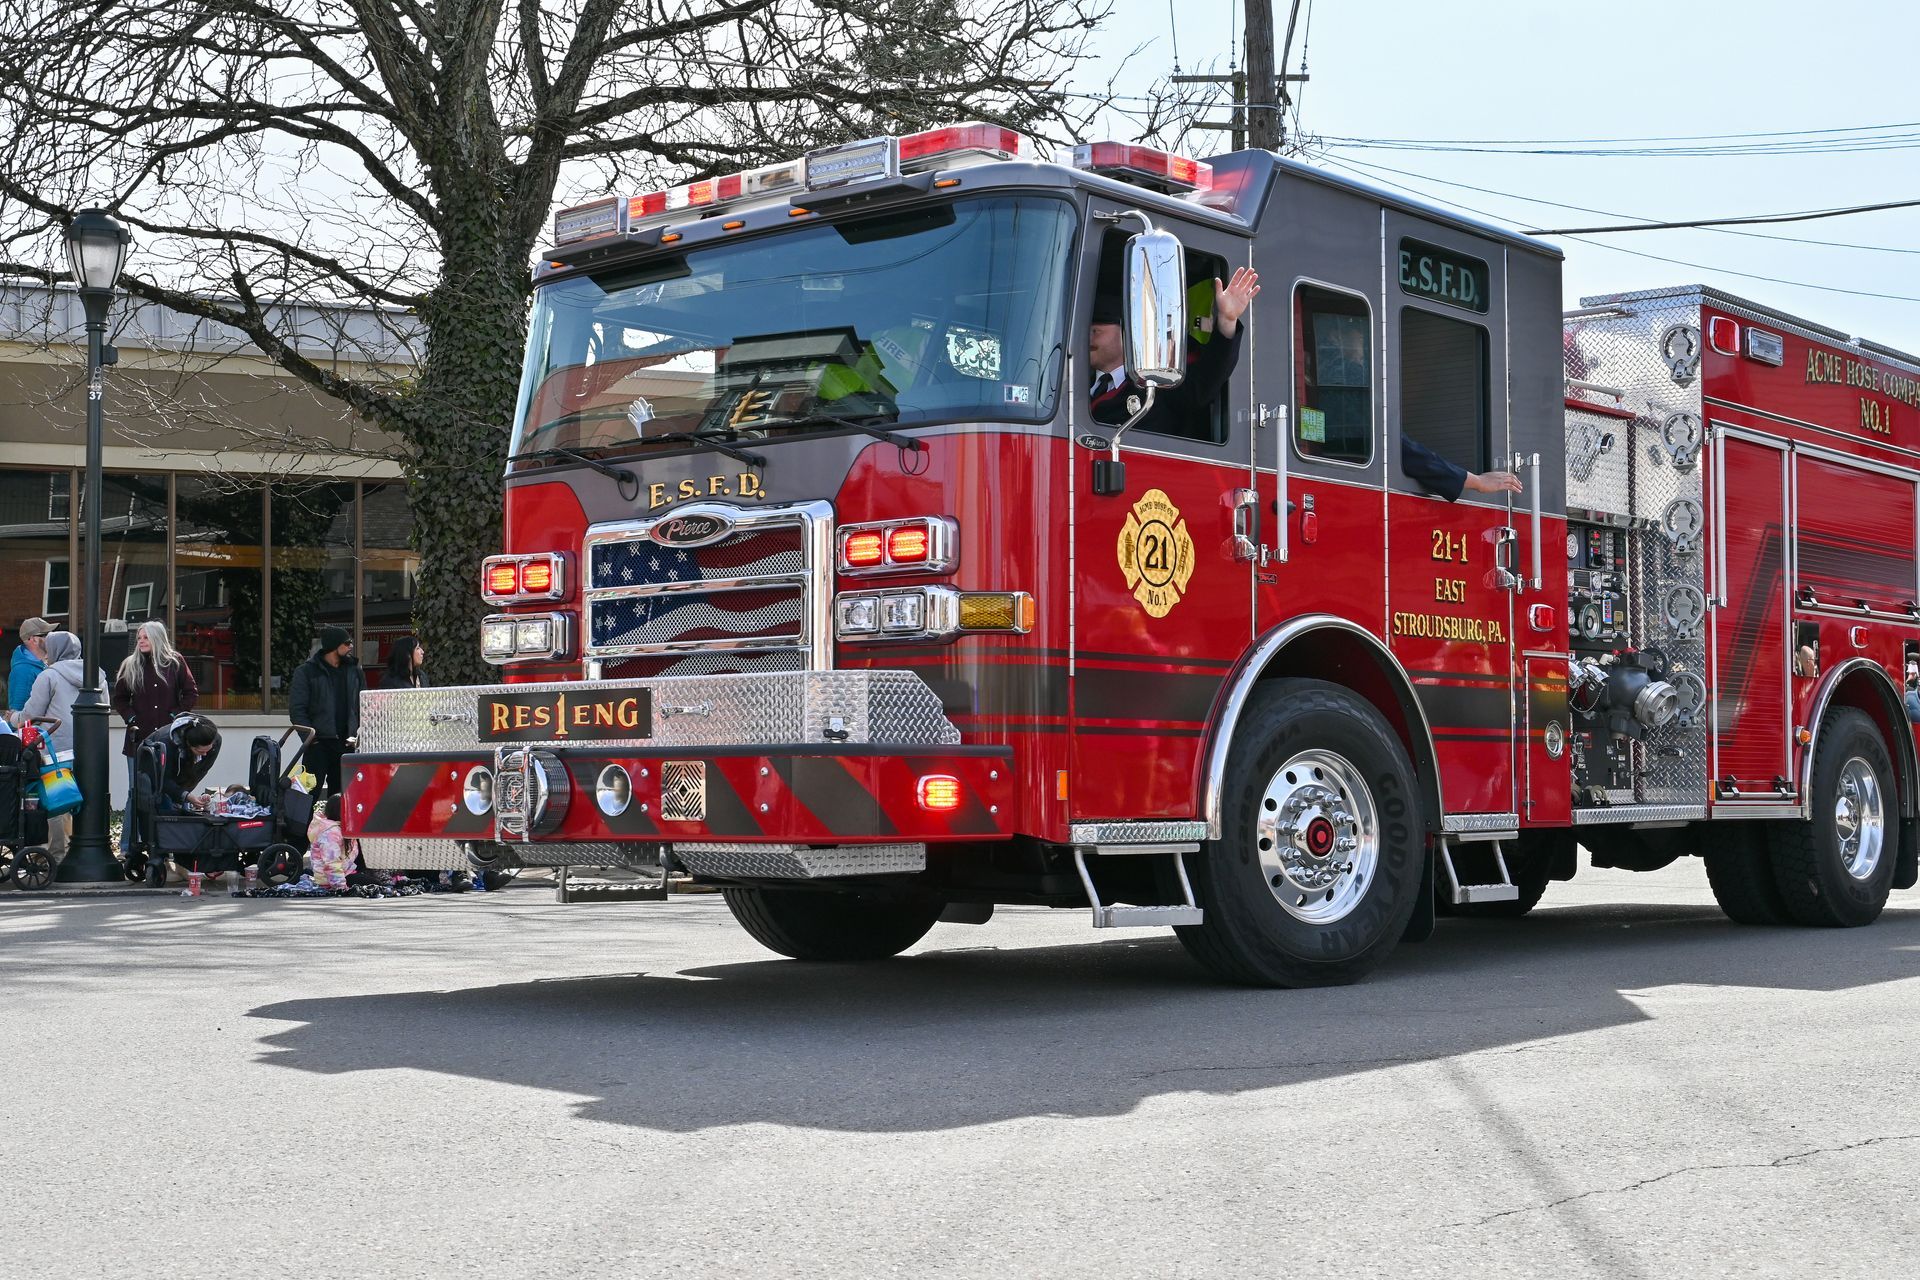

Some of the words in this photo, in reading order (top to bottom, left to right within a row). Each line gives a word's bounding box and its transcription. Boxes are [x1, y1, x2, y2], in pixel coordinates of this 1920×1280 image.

[877, 336, 905, 361] FIRE
[1806, 348, 1842, 384] ACME
[1846, 360, 1880, 392] HOSE
[89, 391, 103, 400] 37
[1139, 501, 1153, 515] ACME
[1153, 501, 1167, 512] HOSE
[666, 519, 712, 540] Pierce
[1145, 534, 1169, 570] 21
[1432, 529, 1469, 563] 21-1
[1435, 577, 1467, 603] EAST
[1393, 611, 1486, 643] STROUDSBURG,
[1487, 620, 1506, 643] PA.
